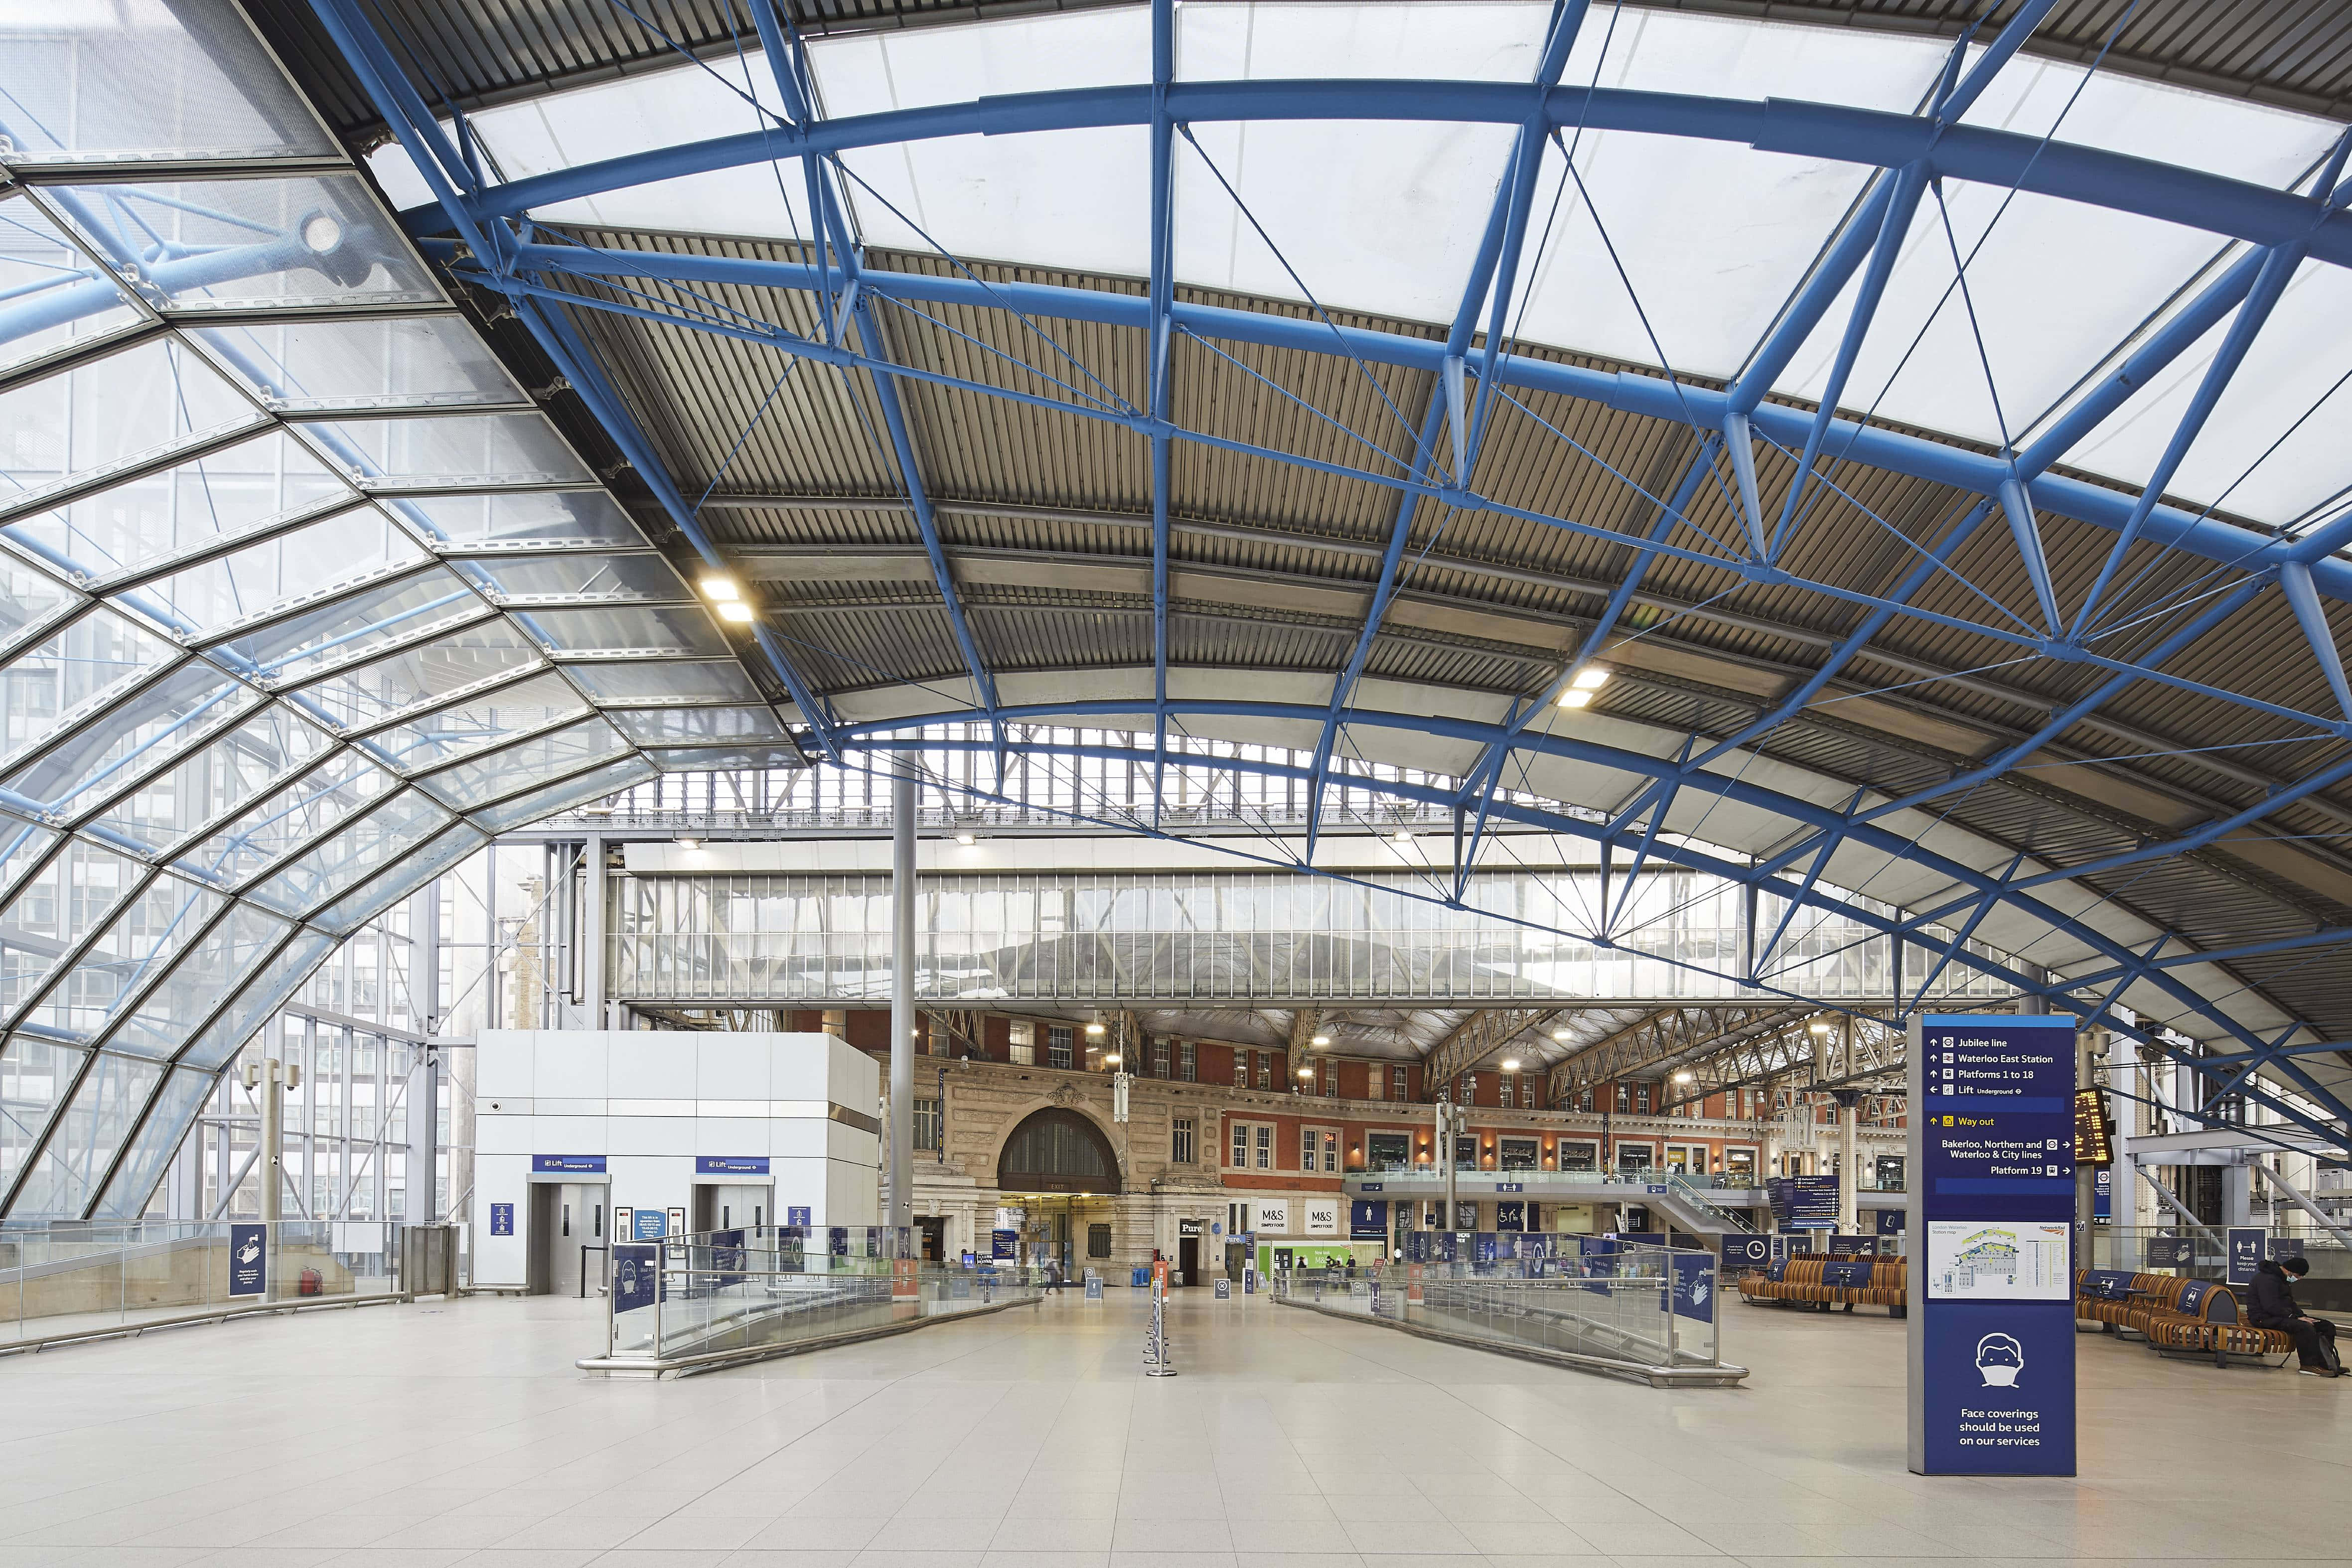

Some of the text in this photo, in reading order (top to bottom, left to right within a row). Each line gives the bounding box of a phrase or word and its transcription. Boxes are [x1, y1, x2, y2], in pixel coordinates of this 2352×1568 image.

[1958, 1038, 2007, 1047] Jubilee line
[1958, 1054, 1998, 1063] Waterloo
[1958, 1070, 2001, 1079] Platforms
[2003, 1070, 2009, 1079] 1
[1958, 1118, 1977, 1127] Way
[1942, 1140, 1982, 1149] Bakerloo,
[1985, 1140, 2024, 1148] Northern
[1950, 1150, 1990, 1158] Waterloo
[2002, 1150, 2020, 1160] City
[2022, 1150, 2042, 1159] lines
[1991, 1166, 2029, 1174] Platform
[1263, 1210, 1284, 1220] M&S
[1312, 1211, 1332, 1222] M&S
[1961, 1409, 2039, 1421] Face coverings
[1959, 1423, 2040, 1432] should be used
[1997, 1436, 2040, 1446] services
